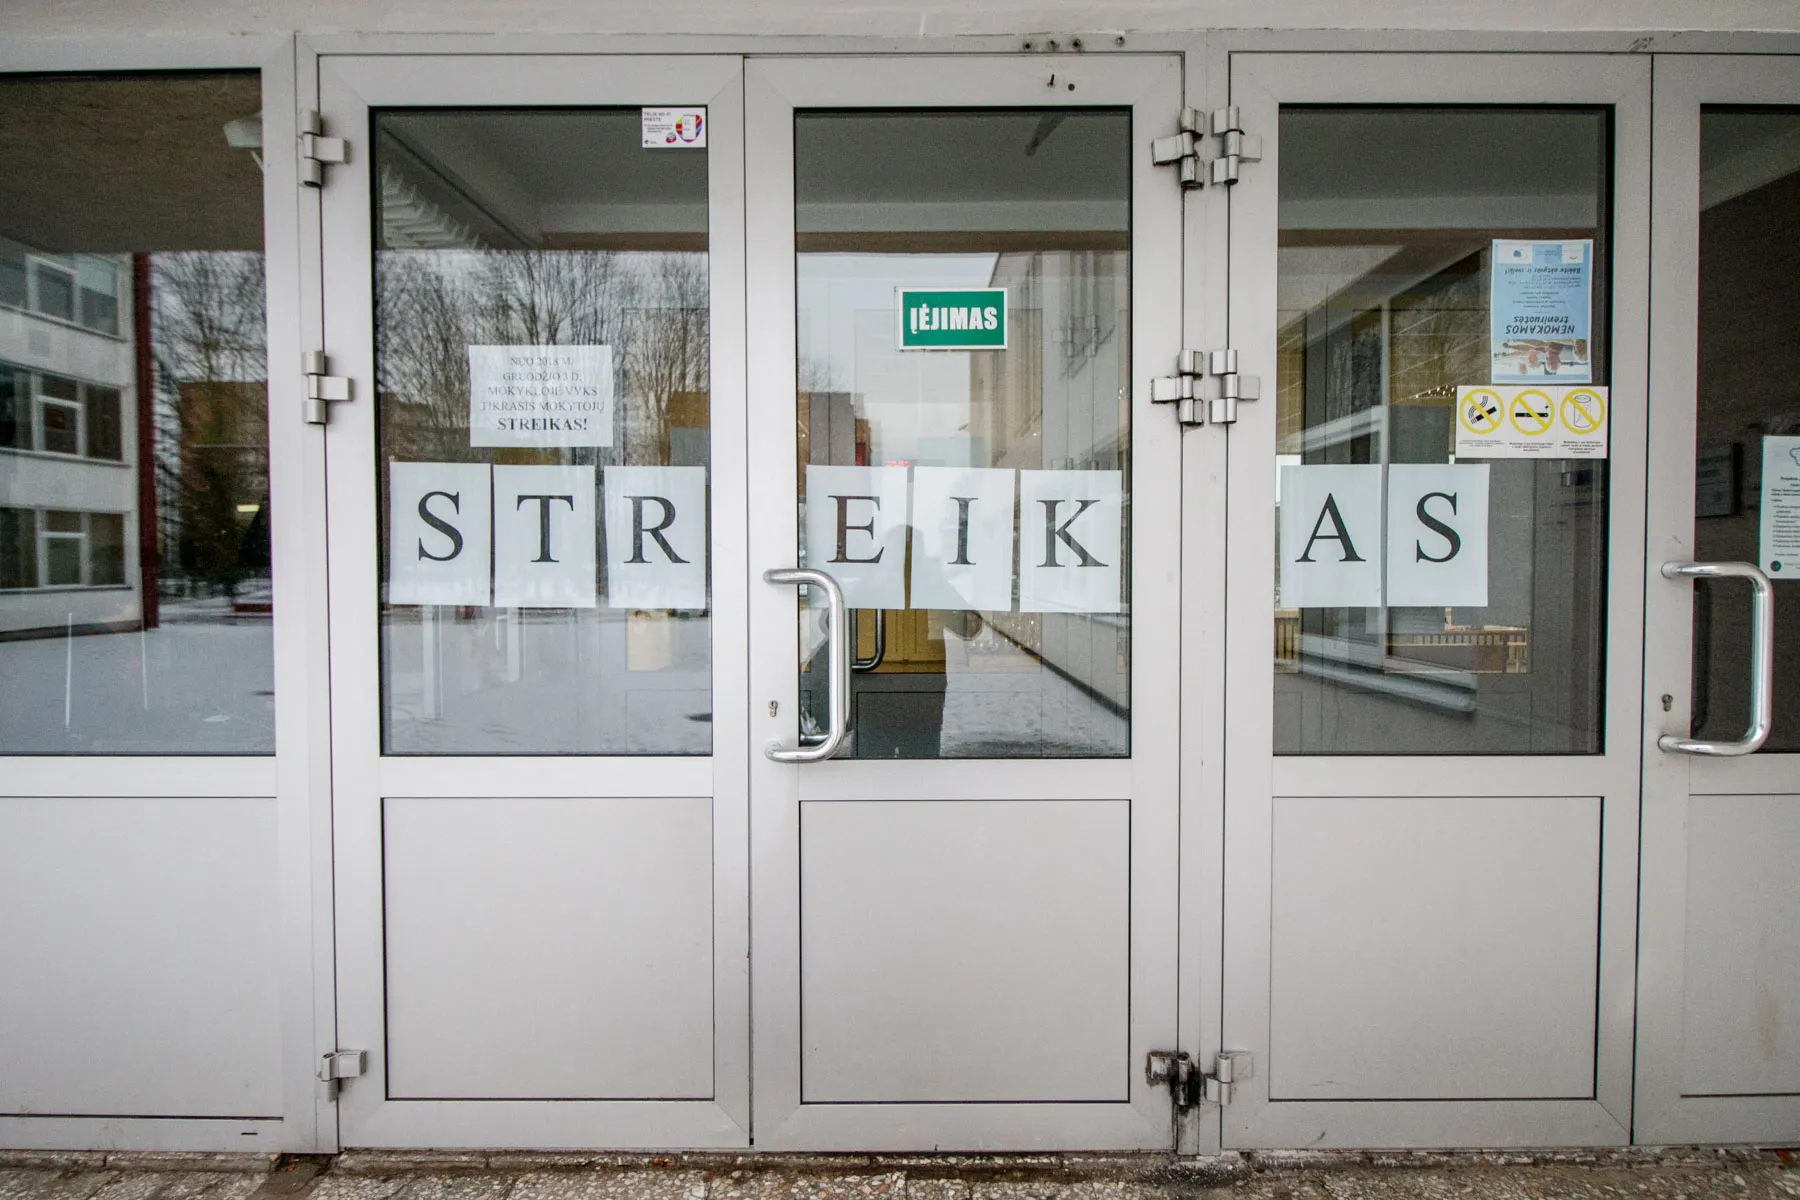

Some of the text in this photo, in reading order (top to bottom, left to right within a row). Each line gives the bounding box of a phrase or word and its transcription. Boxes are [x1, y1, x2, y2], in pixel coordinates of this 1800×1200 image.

[910, 303, 998, 334] ĮĖJIMAS
[1505, 325, 1575, 335] NEMOKAMOS
[510, 357, 534, 366] NUO
[488, 386, 598, 396] MOKYKLOJE VYKS
[481, 401, 605, 413] TIKRASIS MOKYTOJŲ
[497, 418, 587, 431] STREIKAS!
